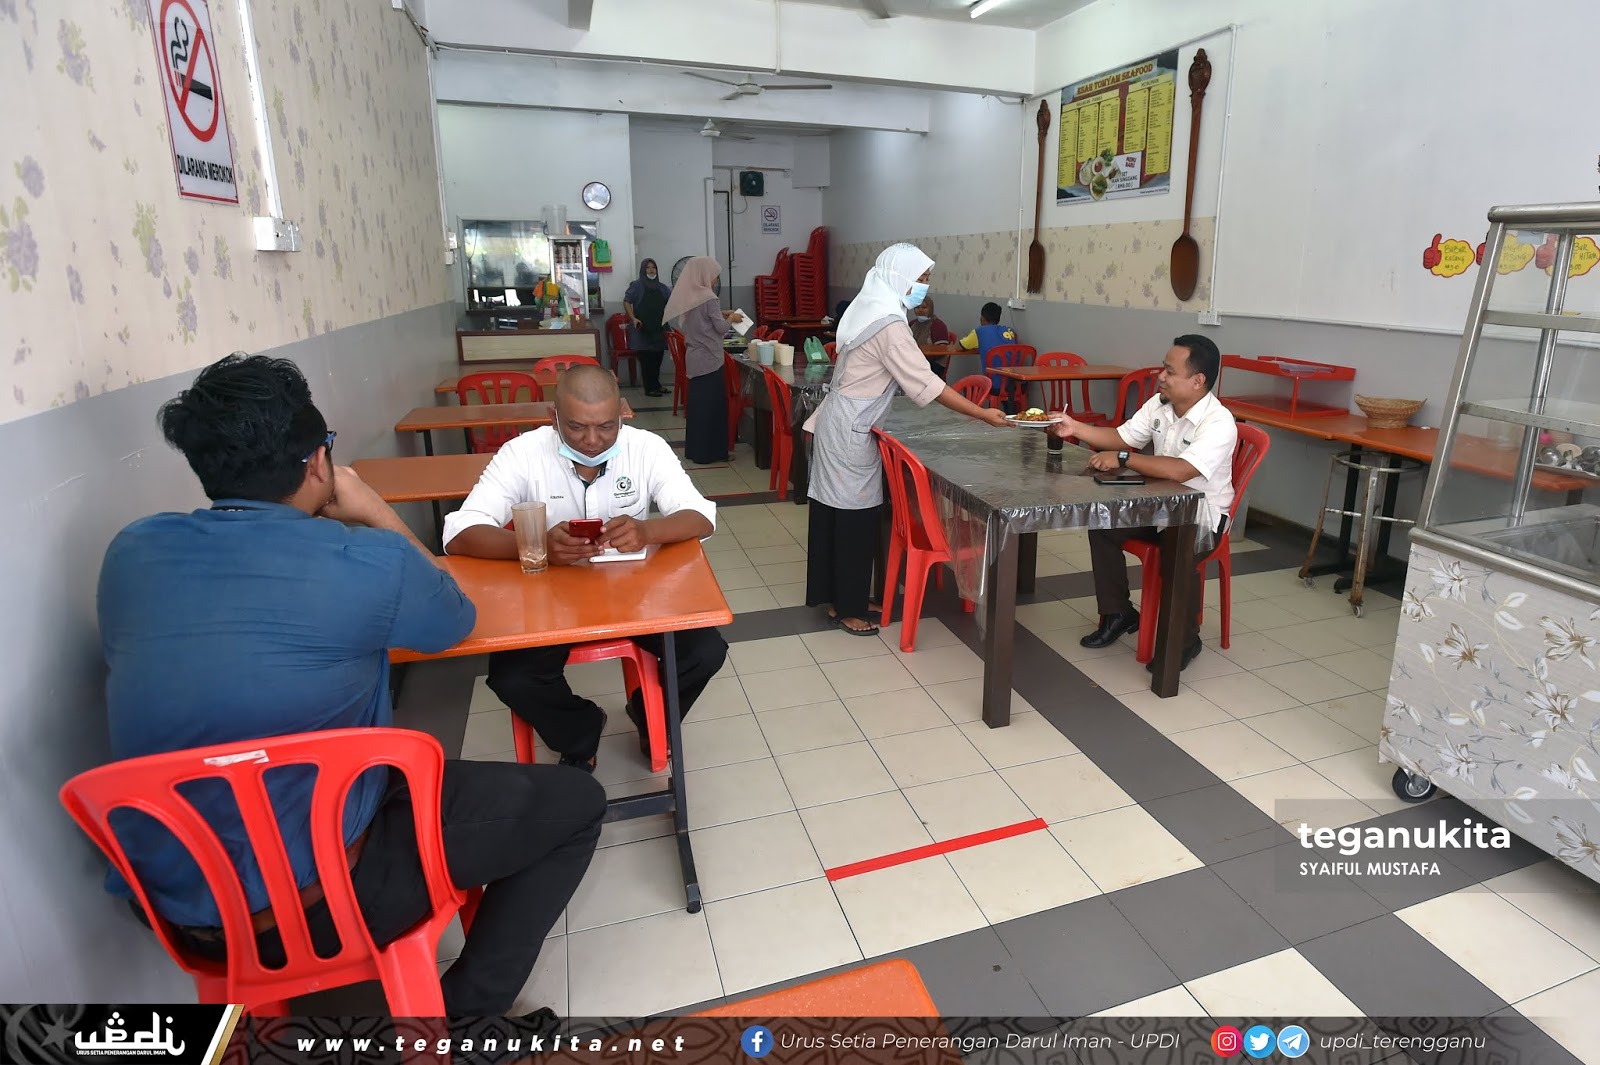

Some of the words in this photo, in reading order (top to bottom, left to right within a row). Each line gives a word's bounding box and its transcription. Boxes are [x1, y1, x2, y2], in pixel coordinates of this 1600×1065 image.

[1121, 63, 1154, 81] SEAFOOD
[177, 154, 208, 180] DILARANG
[206, 161, 235, 185] MEROKOK
